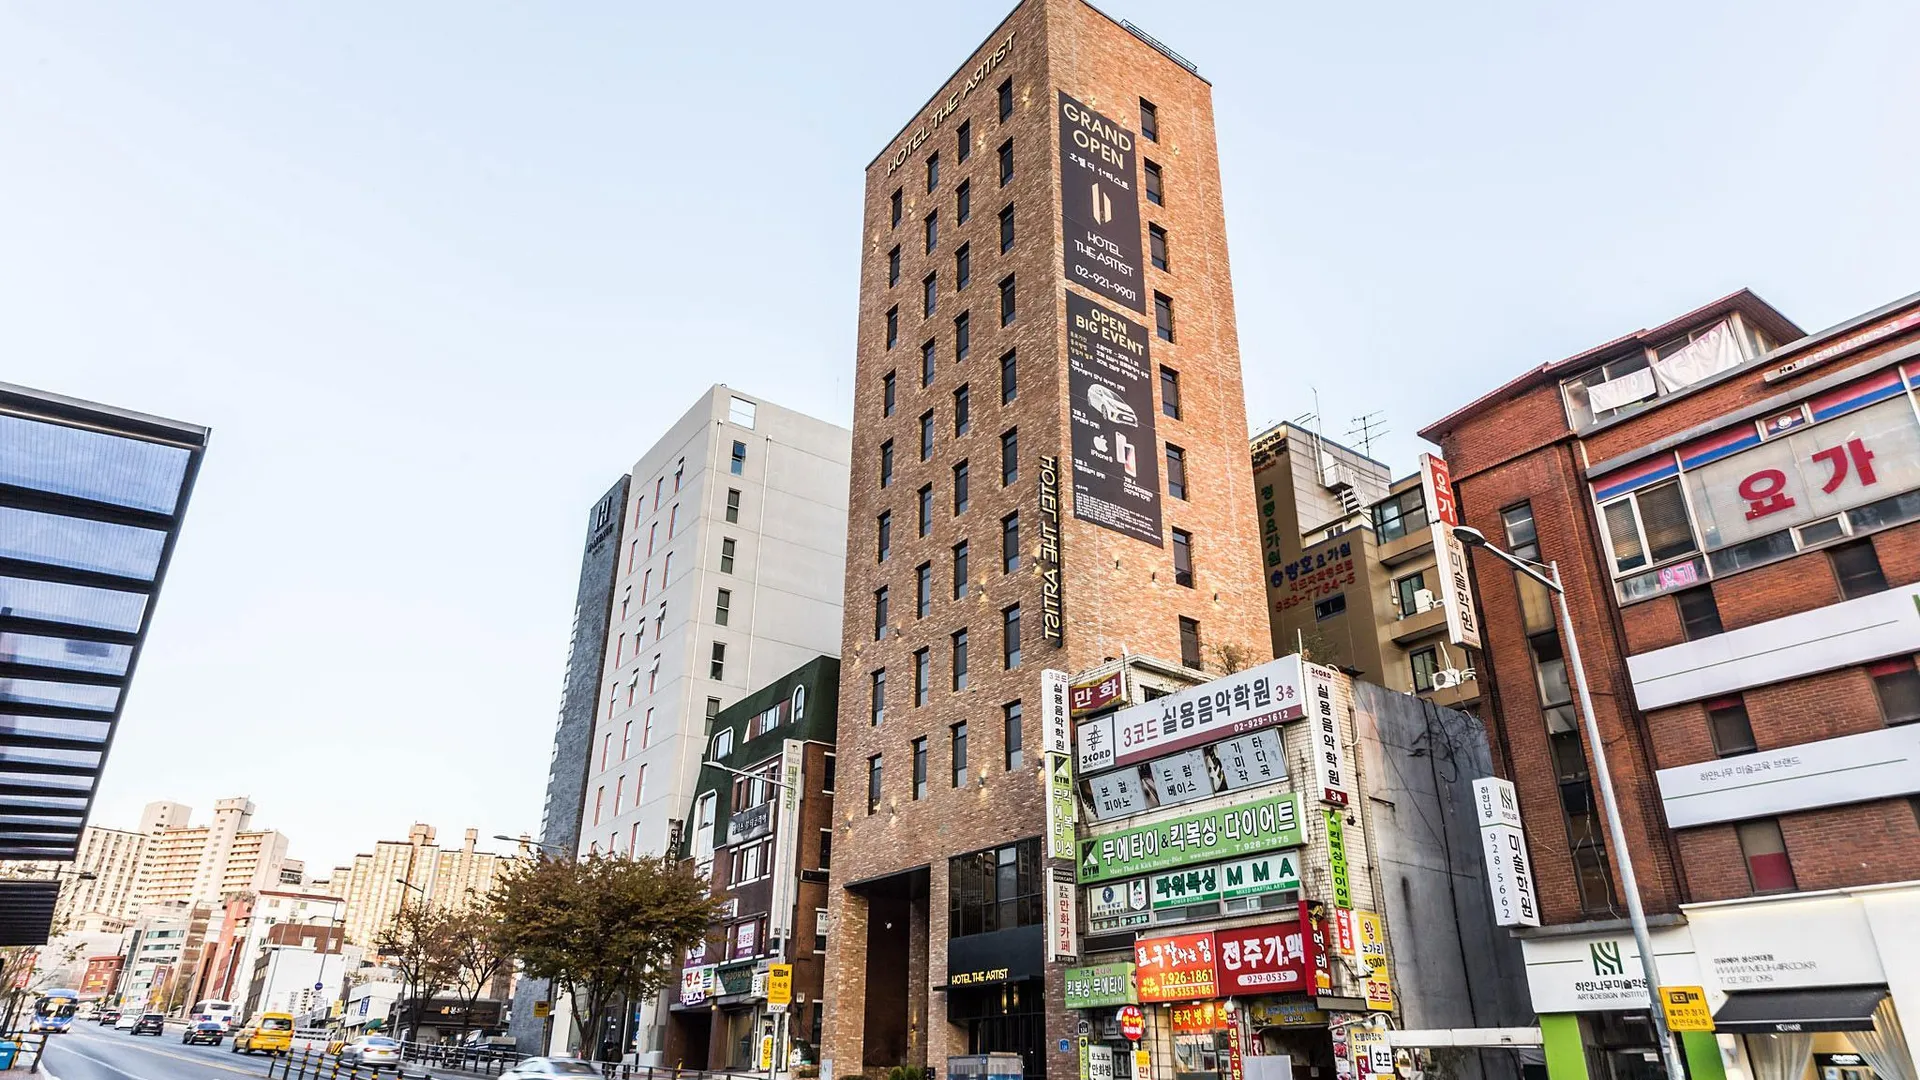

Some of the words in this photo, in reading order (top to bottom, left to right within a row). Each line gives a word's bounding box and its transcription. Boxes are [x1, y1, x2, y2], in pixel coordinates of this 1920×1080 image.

[887, 126, 931, 176] HOTEL
[932, 92, 960, 128] THE
[963, 31, 1017, 98] ARTIST
[1064, 102, 1132, 151] GRAND
[1073, 129, 1124, 170] OPEN
[1087, 231, 1123, 258] HOTEL
[1074, 239, 1096, 260] THE
[1096, 253, 1134, 277] ARTIST
[1075, 264, 1136, 301] 02-921-9901
[1076, 314, 1098, 333] BIG
[1102, 326, 1144, 356] EVENT
[1091, 309, 1127, 335] OPEN
[1737, 437, 1878, 521] 요가
[1436, 472, 1454, 523] 요가
[1451, 551, 1475, 633] 미술학원
[1074, 678, 1119, 709] 만화
[1054, 683, 1065, 751] 실용음악학원
[1123, 718, 1158, 748] 3코드
[1162, 676, 1271, 736] 실용음악학원
[1275, 685, 1295, 702] 3층
[1233, 710, 1289, 733] 02-929-1612
[1230, 736, 1263, 755] 기타
[1318, 683, 1340, 786] 실용음악학원
[1163, 764, 1193, 782] 드럼
[1235, 751, 1267, 769] 미디
[1700, 767, 1734, 781] 하얀나무
[1735, 760, 1771, 775] 미술교육
[1773, 756, 1801, 769] 브랜드
[1238, 765, 1271, 783] 작곡
[1101, 782, 1128, 798] 보컬
[1167, 781, 1197, 797] 베이스
[1104, 797, 1131, 812] 피아노
[1481, 786, 1493, 819] 하얀나무
[1054, 788, 1065, 855] 무에타이
[1063, 789, 1074, 857] 킥복싱
[1082, 865, 1100, 876] GYM
[1156, 867, 1217, 899] 파워복싱
[1508, 833, 1533, 919] 미술학원
[1060, 899, 1070, 952] 만화카페
[1364, 921, 1374, 940] 왕
[1363, 942, 1384, 955] 노가리
[952, 974, 972, 985] HOTEL
[972, 971, 985, 982] THE
[985, 968, 1008, 981] ARTIST
[1160, 968, 1214, 985] T.926-1861
[1247, 972, 1287, 984] 929-0535
[1368, 980, 1391, 1003] 호프
[1620, 990, 1649, 998] INSTITUT
[1091, 1064, 1111, 1077] 만화방
[1375, 1050, 1391, 1067] 호프
